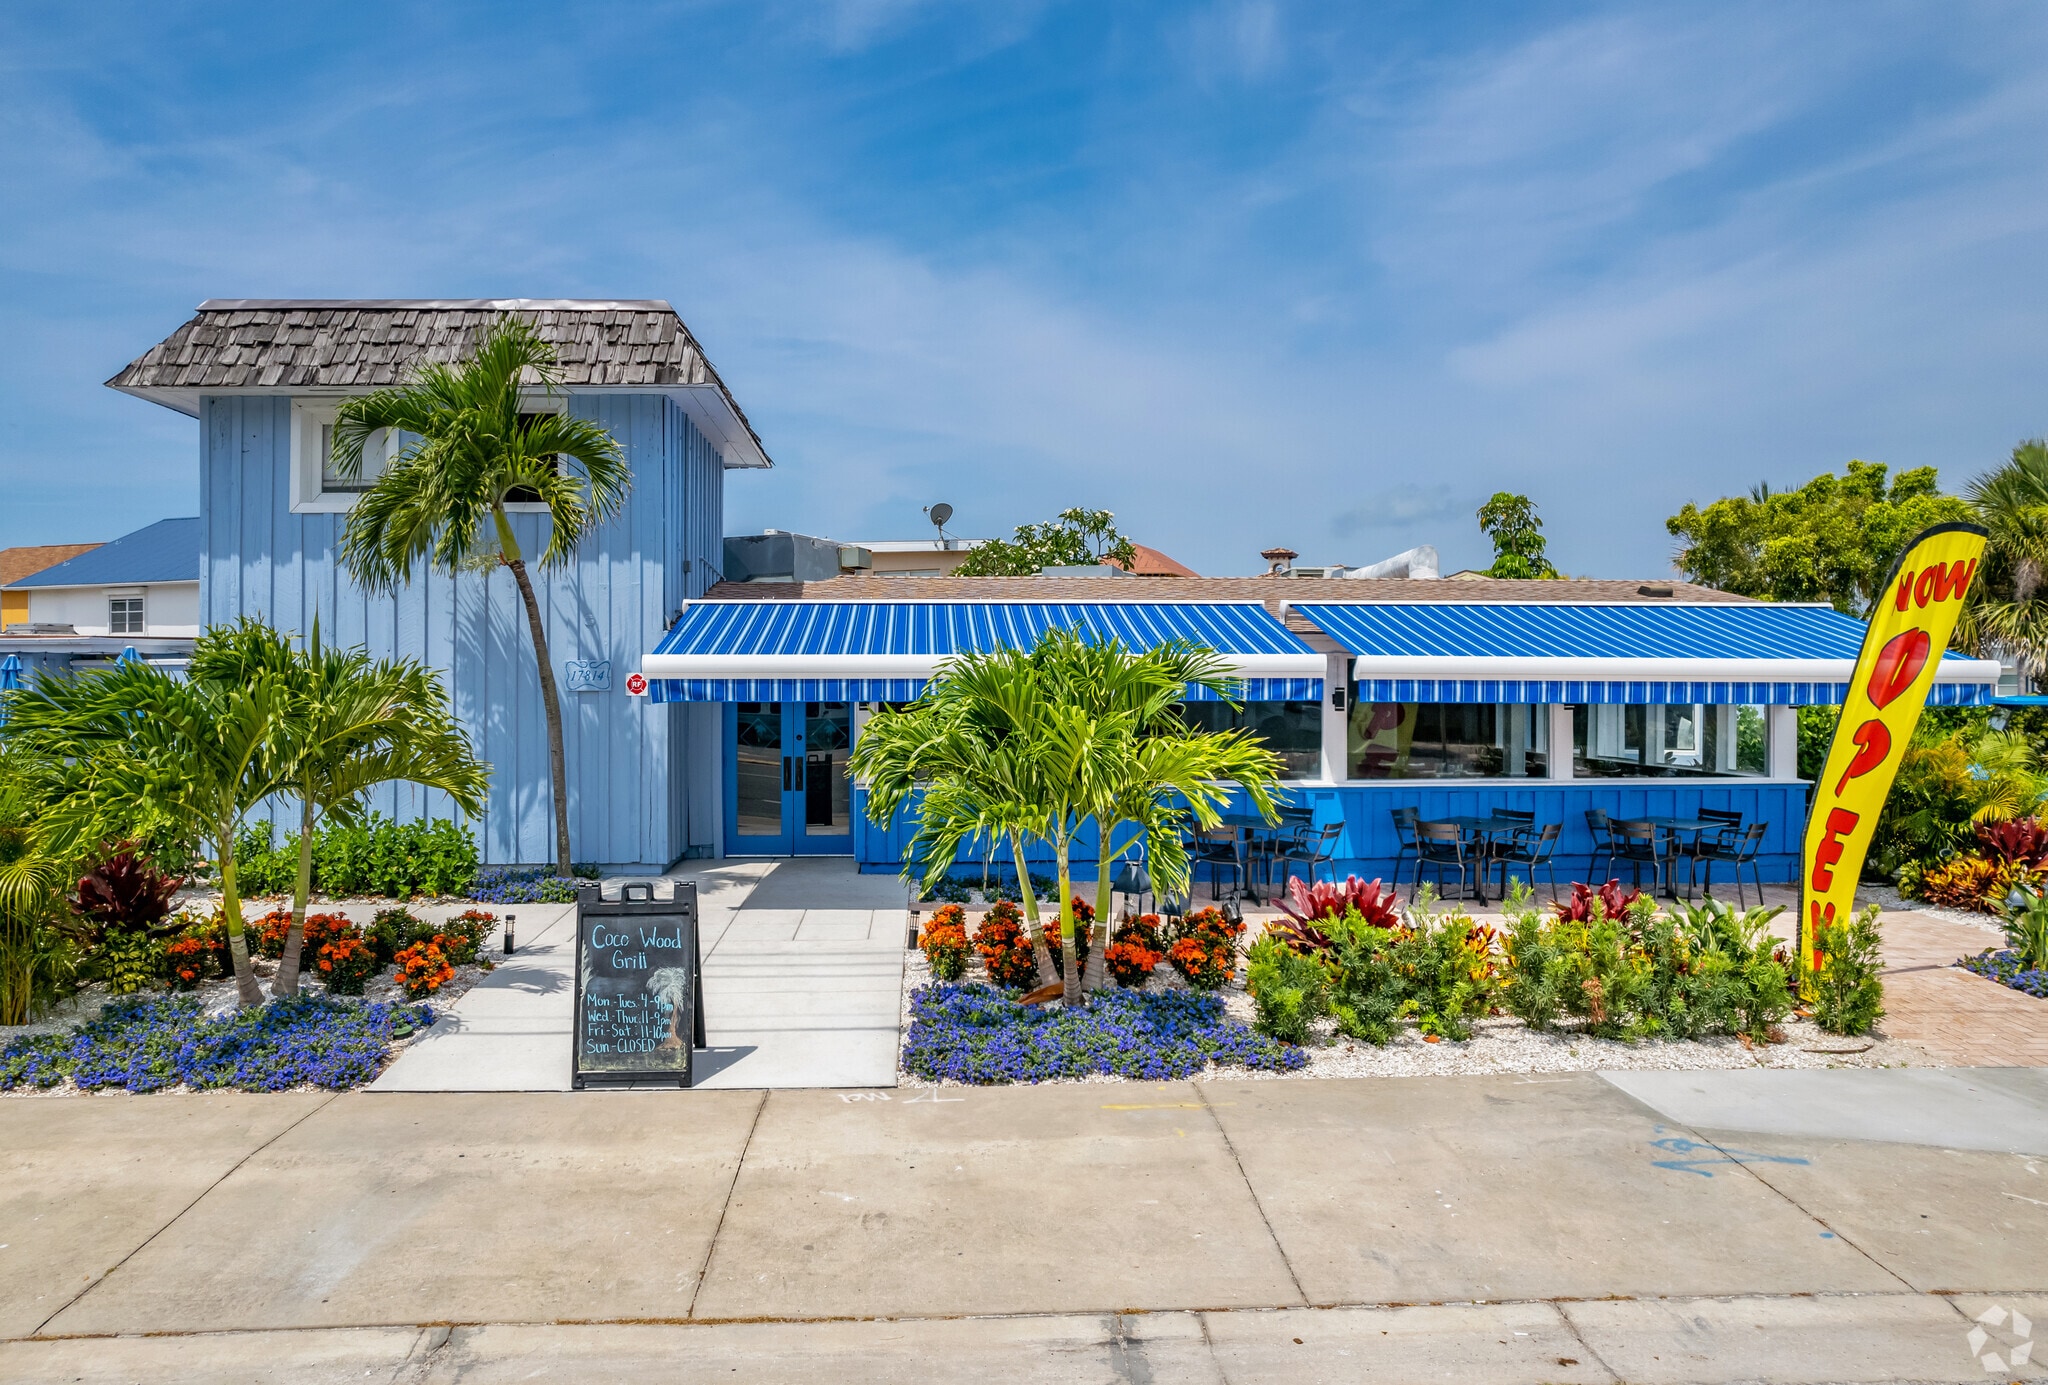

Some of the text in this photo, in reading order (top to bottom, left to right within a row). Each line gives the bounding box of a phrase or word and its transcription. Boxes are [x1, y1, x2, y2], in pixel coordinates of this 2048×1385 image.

[1893, 557, 1977, 612] NOW
[570, 670, 604, 681] 17814
[592, 924, 682, 949] Coco Wood
[612, 949, 647, 968] Grill
